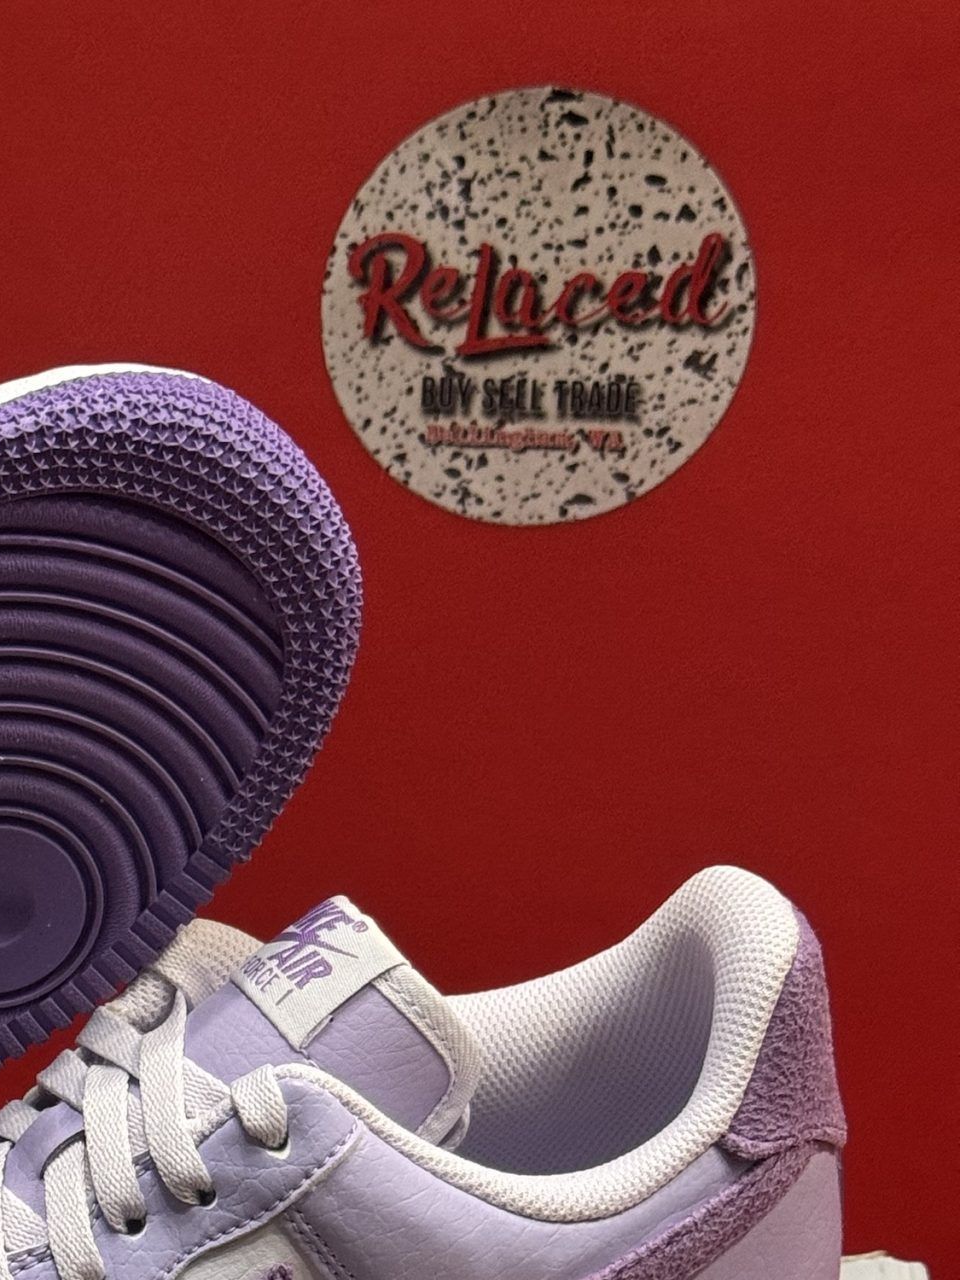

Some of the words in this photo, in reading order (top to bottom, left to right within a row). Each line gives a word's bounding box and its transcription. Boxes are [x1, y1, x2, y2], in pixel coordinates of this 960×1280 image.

[421, 376, 472, 410] BUY
[482, 377, 542, 412] SELL
[553, 379, 640, 415] TRADE
[241, 956, 281, 993] FORCE
[266, 944, 333, 990] AIR
